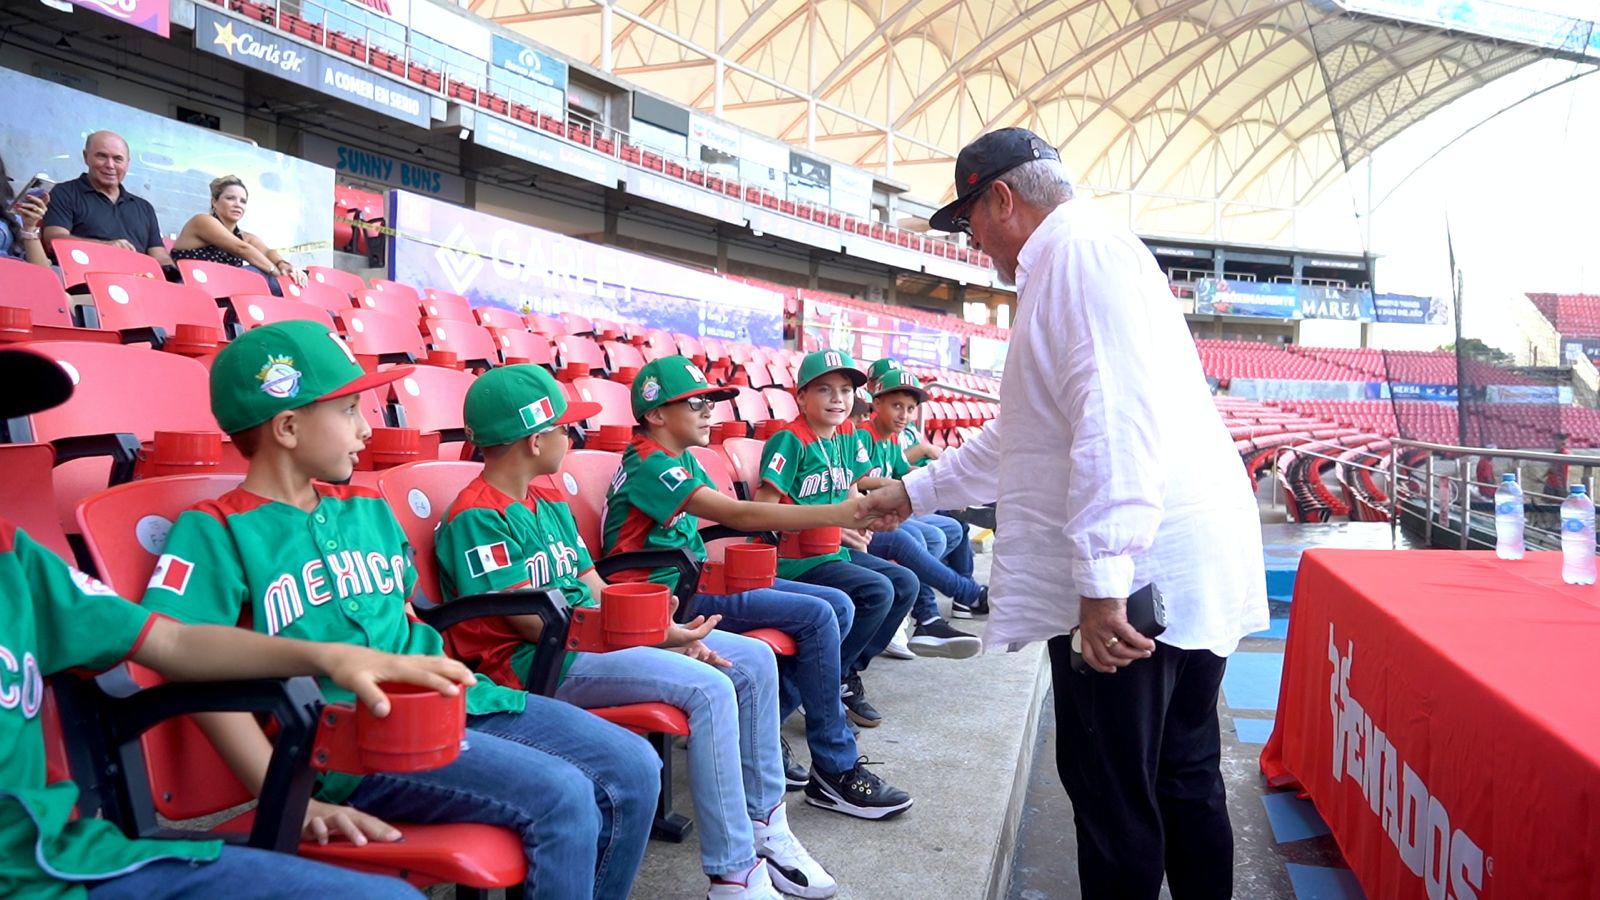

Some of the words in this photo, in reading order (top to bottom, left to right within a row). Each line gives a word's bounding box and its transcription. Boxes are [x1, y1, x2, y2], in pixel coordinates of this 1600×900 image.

[237, 33, 280, 65] Carl's
[281, 49, 302, 73] Jr.
[324, 67, 335, 86] A
[335, 72, 374, 100] COMER
[374, 87, 389, 105] EN
[389, 92, 420, 116] SERIO
[336, 145, 393, 181] SUNNY
[400, 163, 442, 194] BUNS
[1302, 299, 1361, 320] MAREA
[1325, 288, 1340, 300] LA
[264, 550, 409, 637] MEXICO
[1329, 670, 1483, 900] VENADOS
